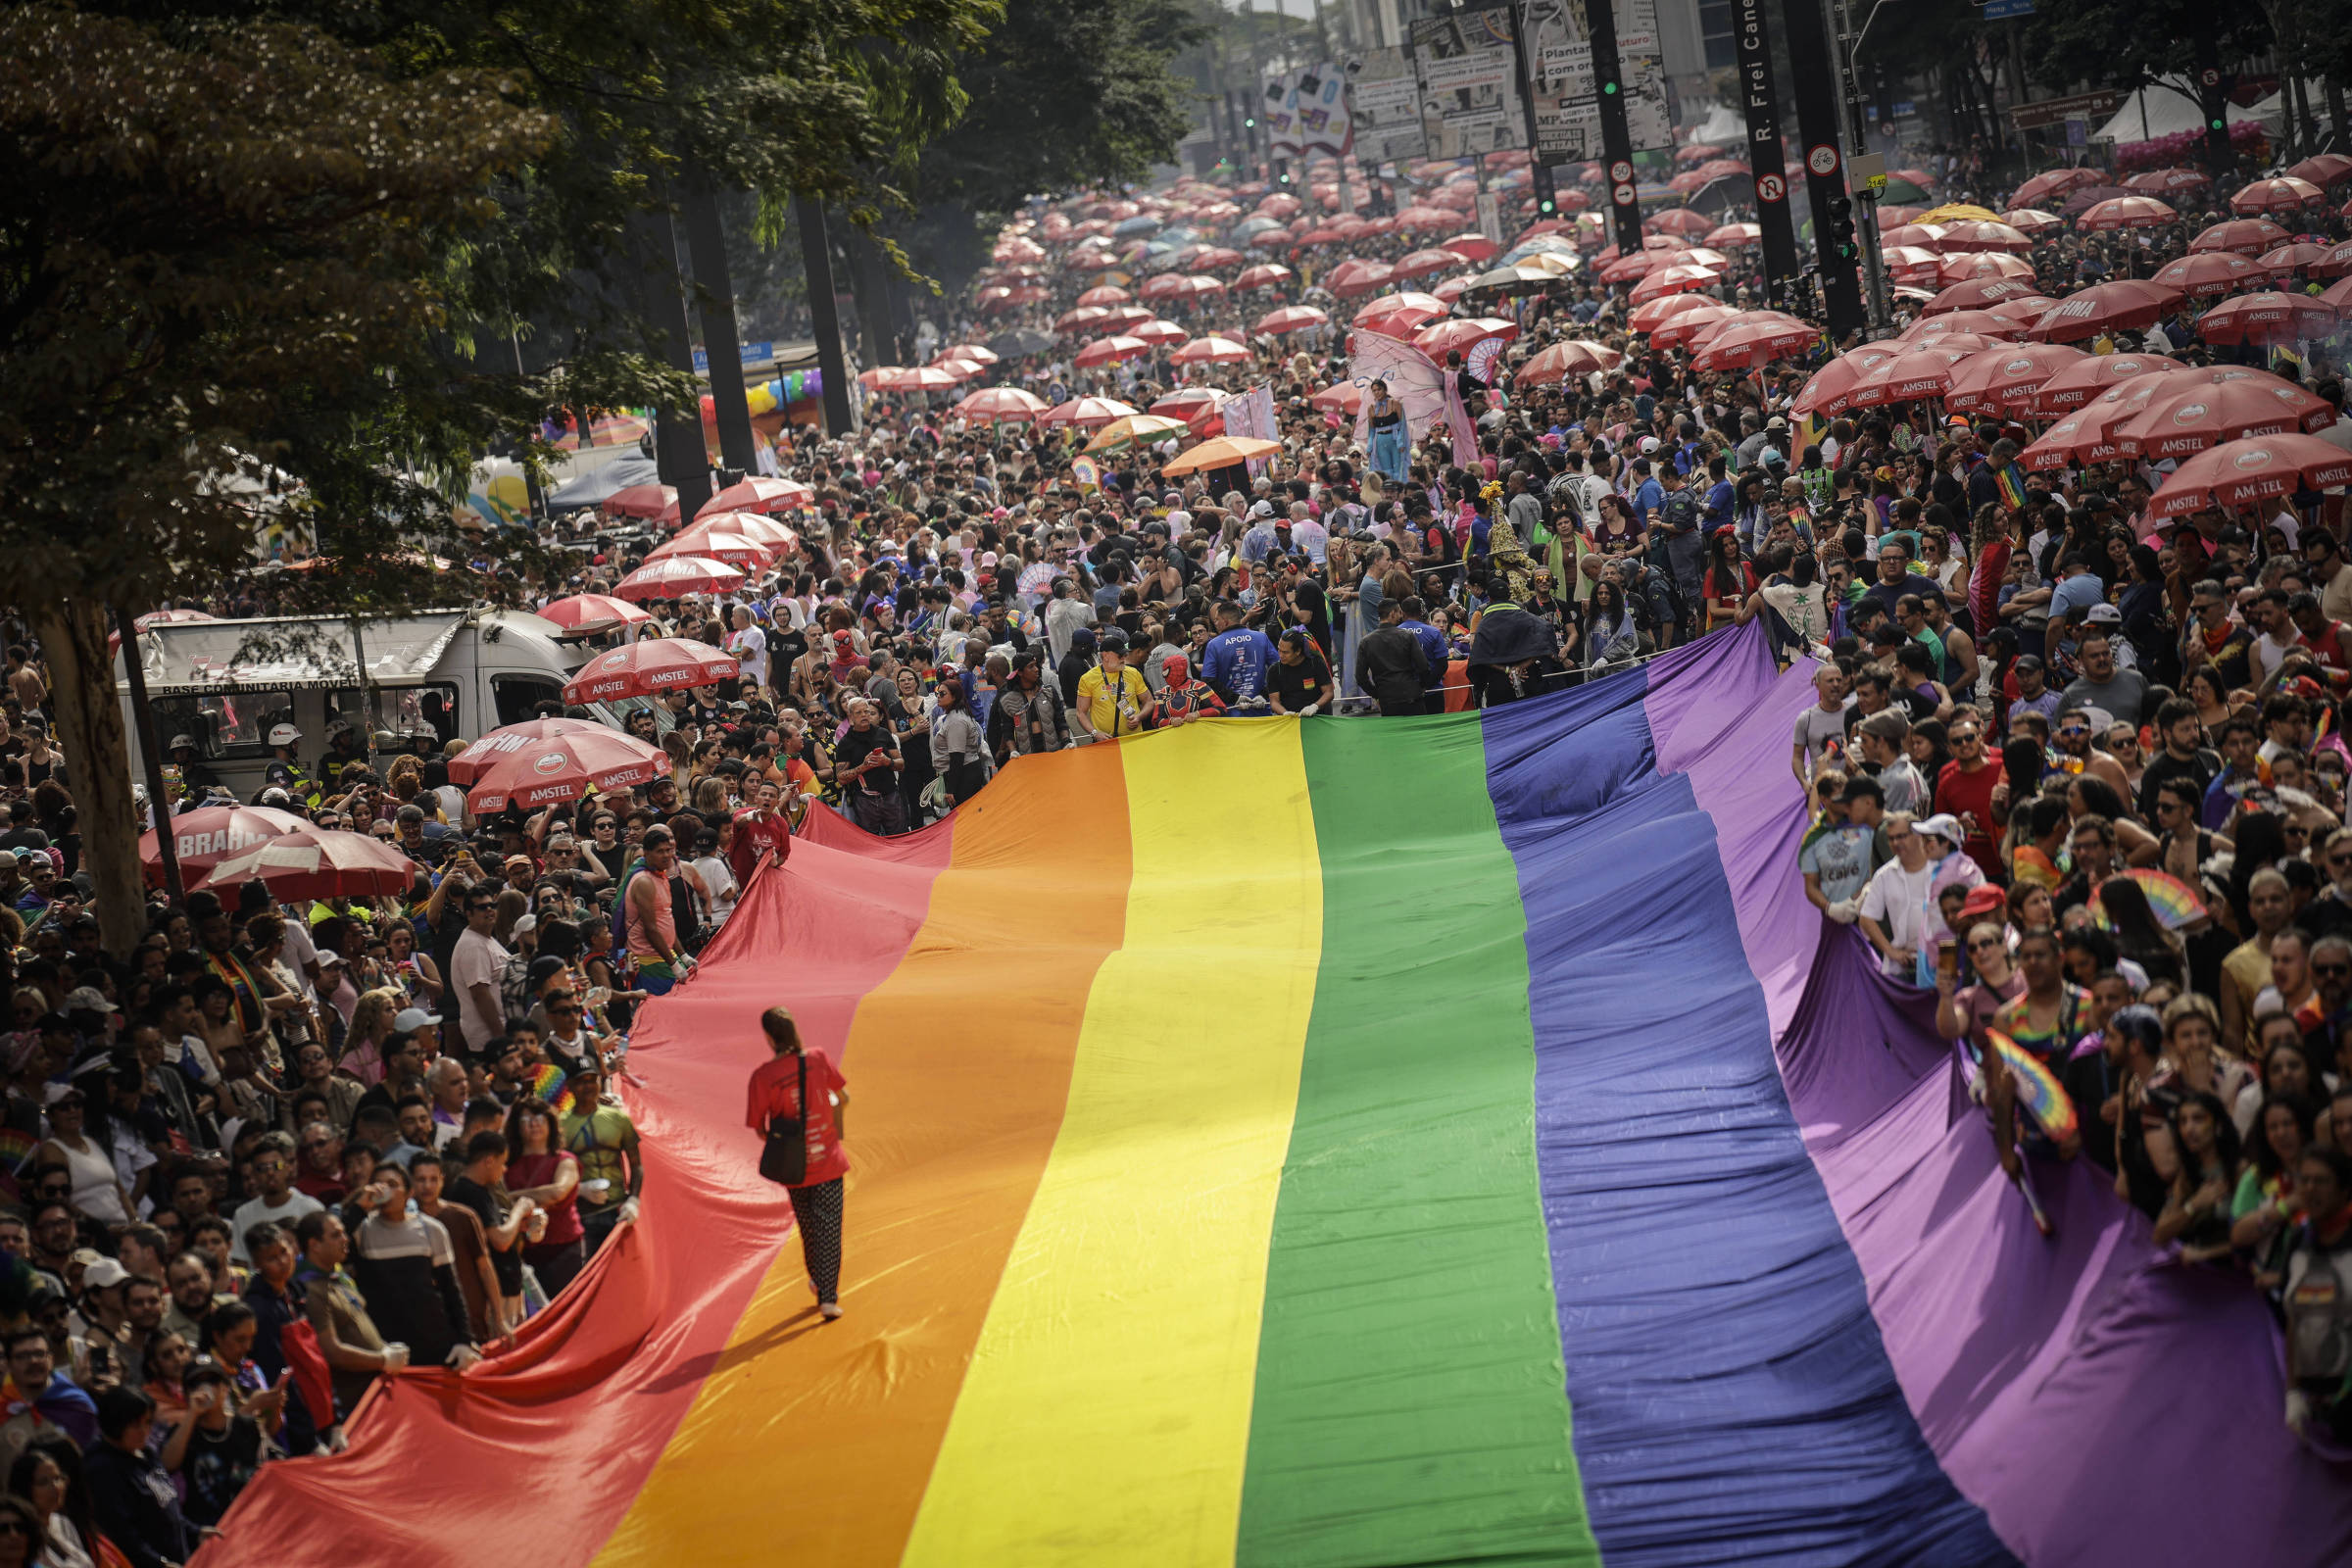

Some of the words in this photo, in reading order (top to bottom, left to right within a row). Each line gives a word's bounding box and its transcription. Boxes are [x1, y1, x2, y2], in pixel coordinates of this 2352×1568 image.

[1545, 45, 1592, 60] Plantar
[1548, 65, 1575, 75] com
[1747, 62, 1767, 107] Frei
[1755, 119, 1773, 141] R.
[1614, 166, 1630, 177] 50
[1866, 176, 1887, 188] 2140
[2274, 202, 2295, 211] AMSTEL
[2131, 218, 2152, 226] AMSTEL
[2234, 245, 2258, 255] AMSTEL
[2243, 274, 2265, 286] AMSTEL
[2196, 282, 2226, 294] AMSTEL
[2207, 316, 2230, 328] AMSTEL
[2249, 312, 2281, 321] AMSTEL
[2302, 312, 2327, 321] AMSTEL
[1771, 336, 1796, 348] AMSTEL
[1725, 344, 1751, 357] AMSTEL
[1902, 379, 1938, 393] AMSTEL
[1856, 388, 1880, 403] AMSTEL
[1953, 395, 1978, 409] AMSTEL
[2053, 391, 2084, 404] AMSTEL
[2161, 437, 2204, 453] AMSTEL
[2034, 453, 2063, 466] AMSTEL
[2315, 467, 2351, 484] AMSTEL
[2234, 478, 2284, 499] AMSTEL
[770, 495, 794, 508] AMSTEL
[2165, 494, 2200, 514] AMSTEL
[1225, 634, 1252, 646] APOIO
[710, 664, 732, 675] AMSTEL
[651, 670, 690, 685] AMSTEL
[163, 686, 200, 696] BASE
[592, 680, 625, 696] AMSTEL
[465, 732, 538, 759] BRAHM
[604, 769, 642, 787] AMSTEL
[530, 784, 574, 803] AMSTEL
[478, 795, 504, 809] AMSTEL
